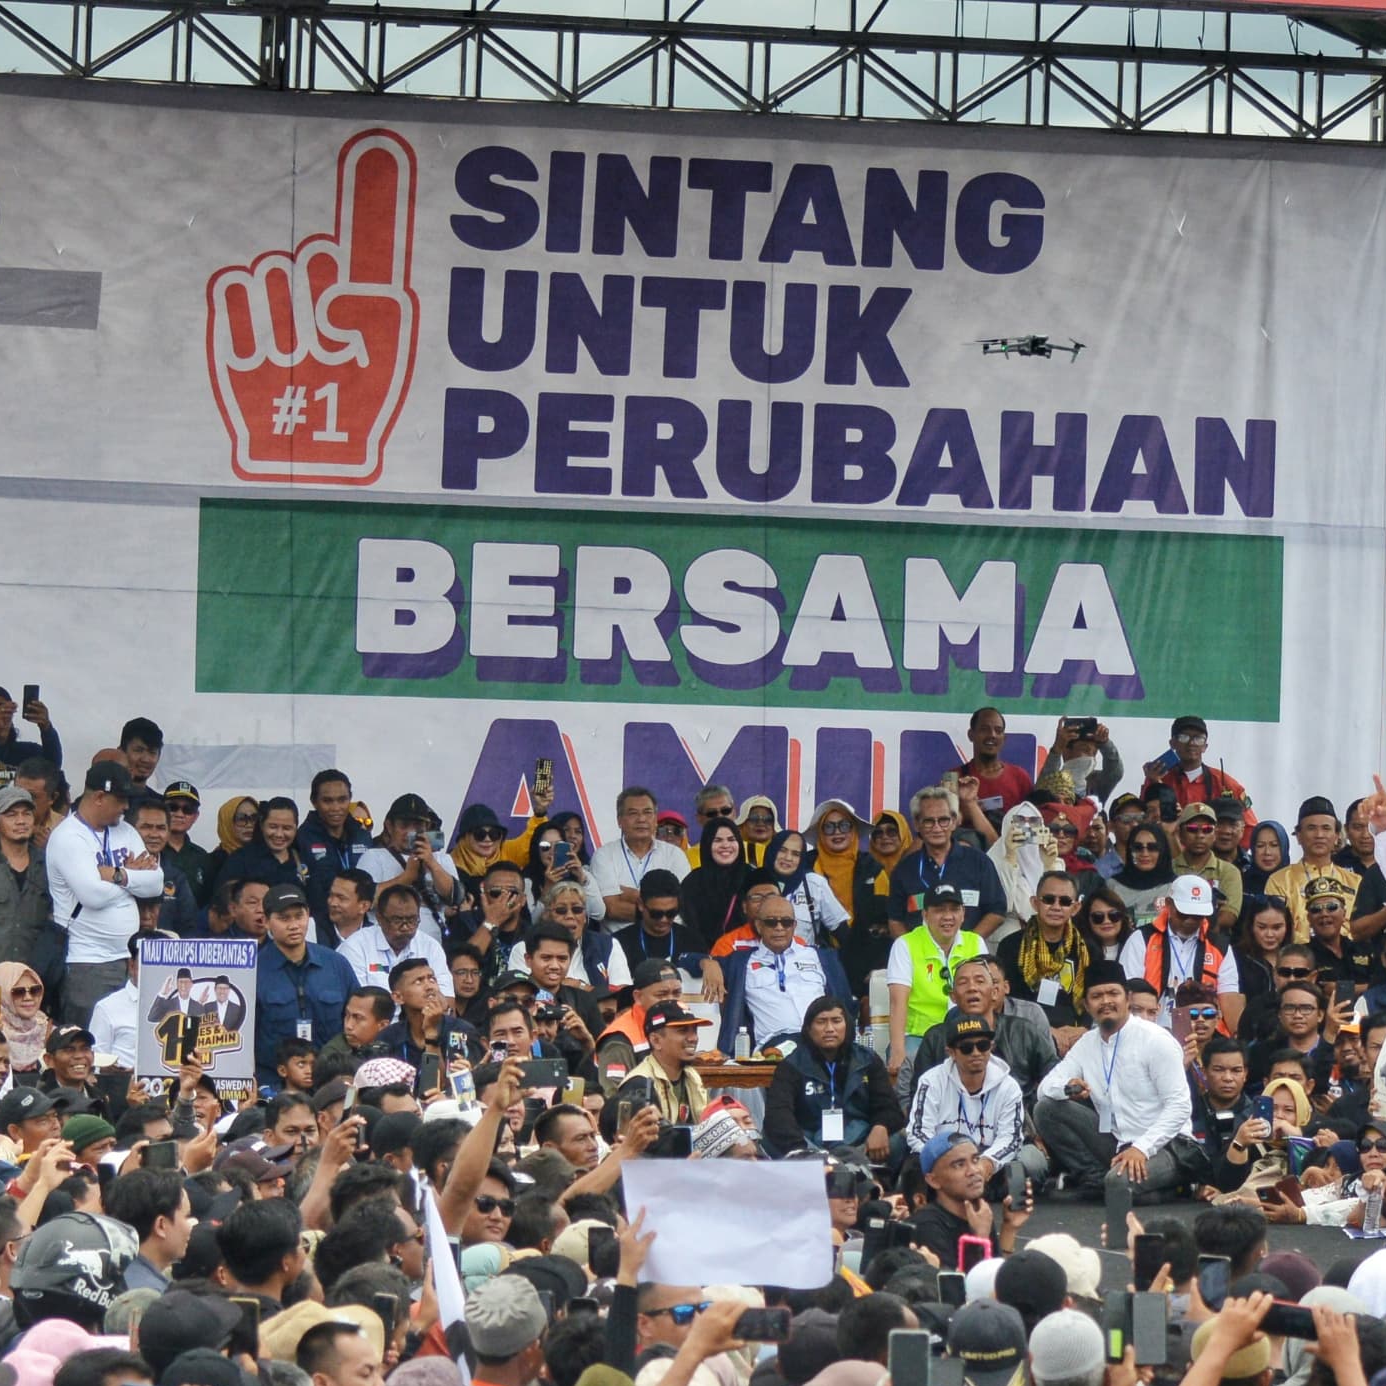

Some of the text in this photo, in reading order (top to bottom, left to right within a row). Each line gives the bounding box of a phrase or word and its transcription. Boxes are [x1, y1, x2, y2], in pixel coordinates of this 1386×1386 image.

[449, 146, 1045, 275] SINTANG
[447, 270, 910, 388] UNTUK
[272, 382, 349, 442] #1
[442, 388, 1277, 518] PERUBAHAN
[356, 537, 1138, 680] BERSAMA
[144, 940, 162, 963] MAU
[163, 941, 198, 964] KORUPSI
[199, 942, 248, 966] DIBERANTAS
[197, 1033, 237, 1047] HAIMIN
[215, 1080, 253, 1091] ASWEDAN
[74, 1277, 99, 1303] Red
